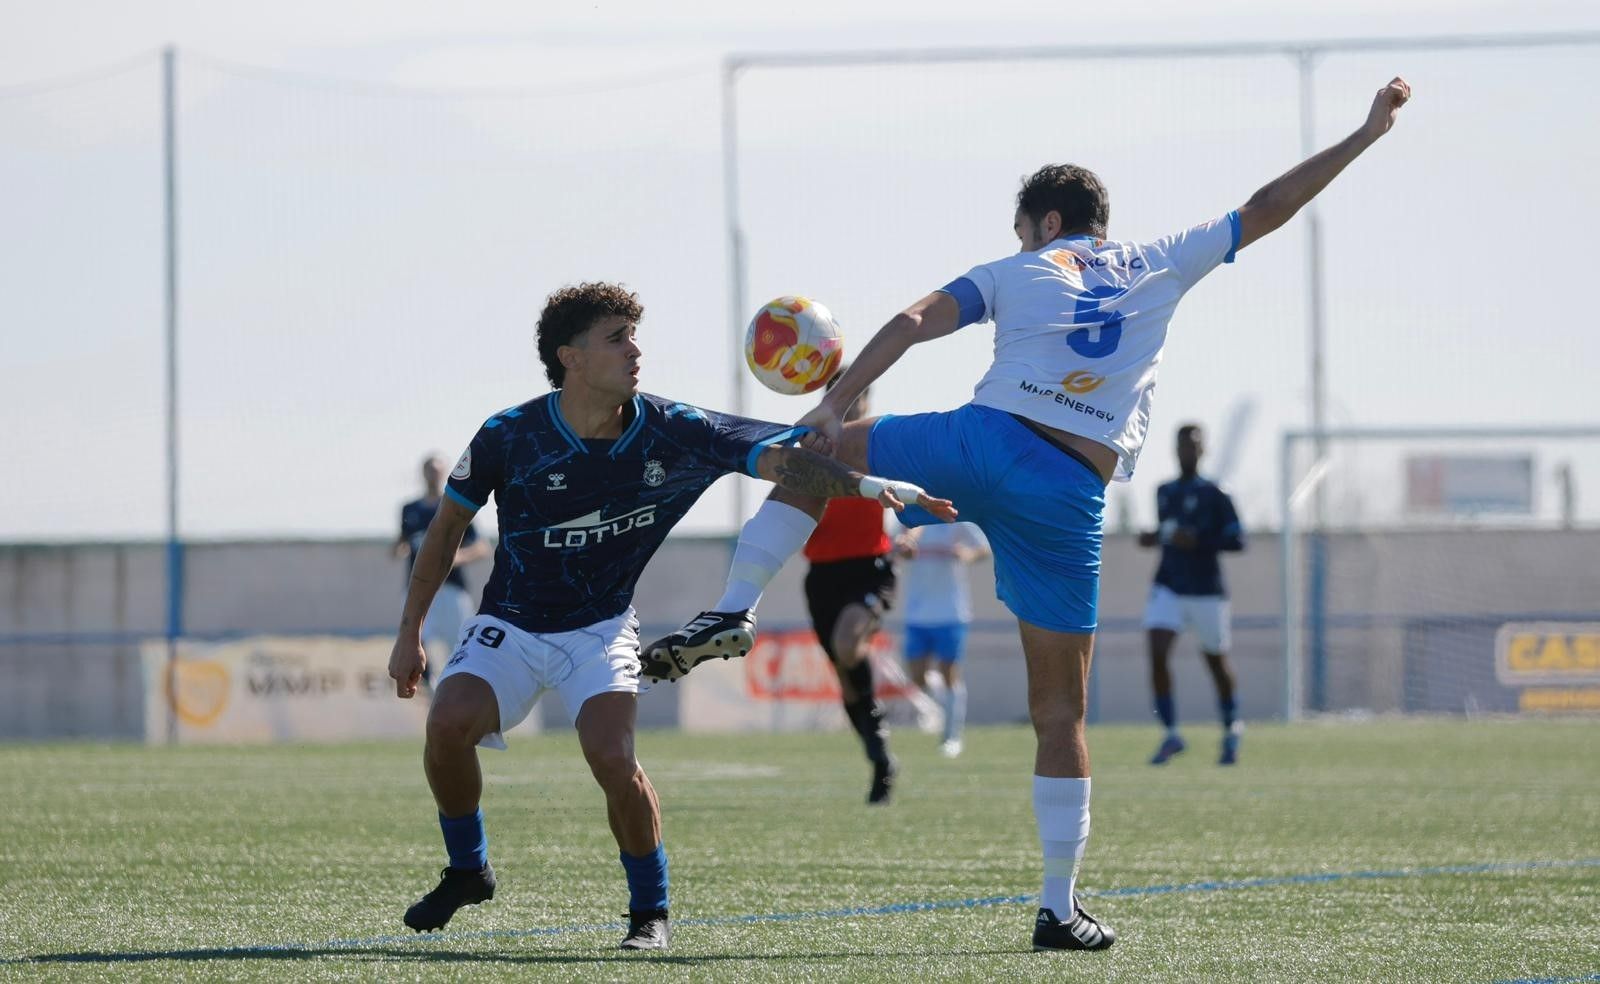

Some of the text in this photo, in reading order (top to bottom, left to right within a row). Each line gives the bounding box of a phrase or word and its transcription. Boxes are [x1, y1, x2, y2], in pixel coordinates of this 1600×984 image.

[1066, 285, 1128, 358] 5
[1055, 393, 1114, 422] ENERGY
[462, 624, 505, 648] 19
